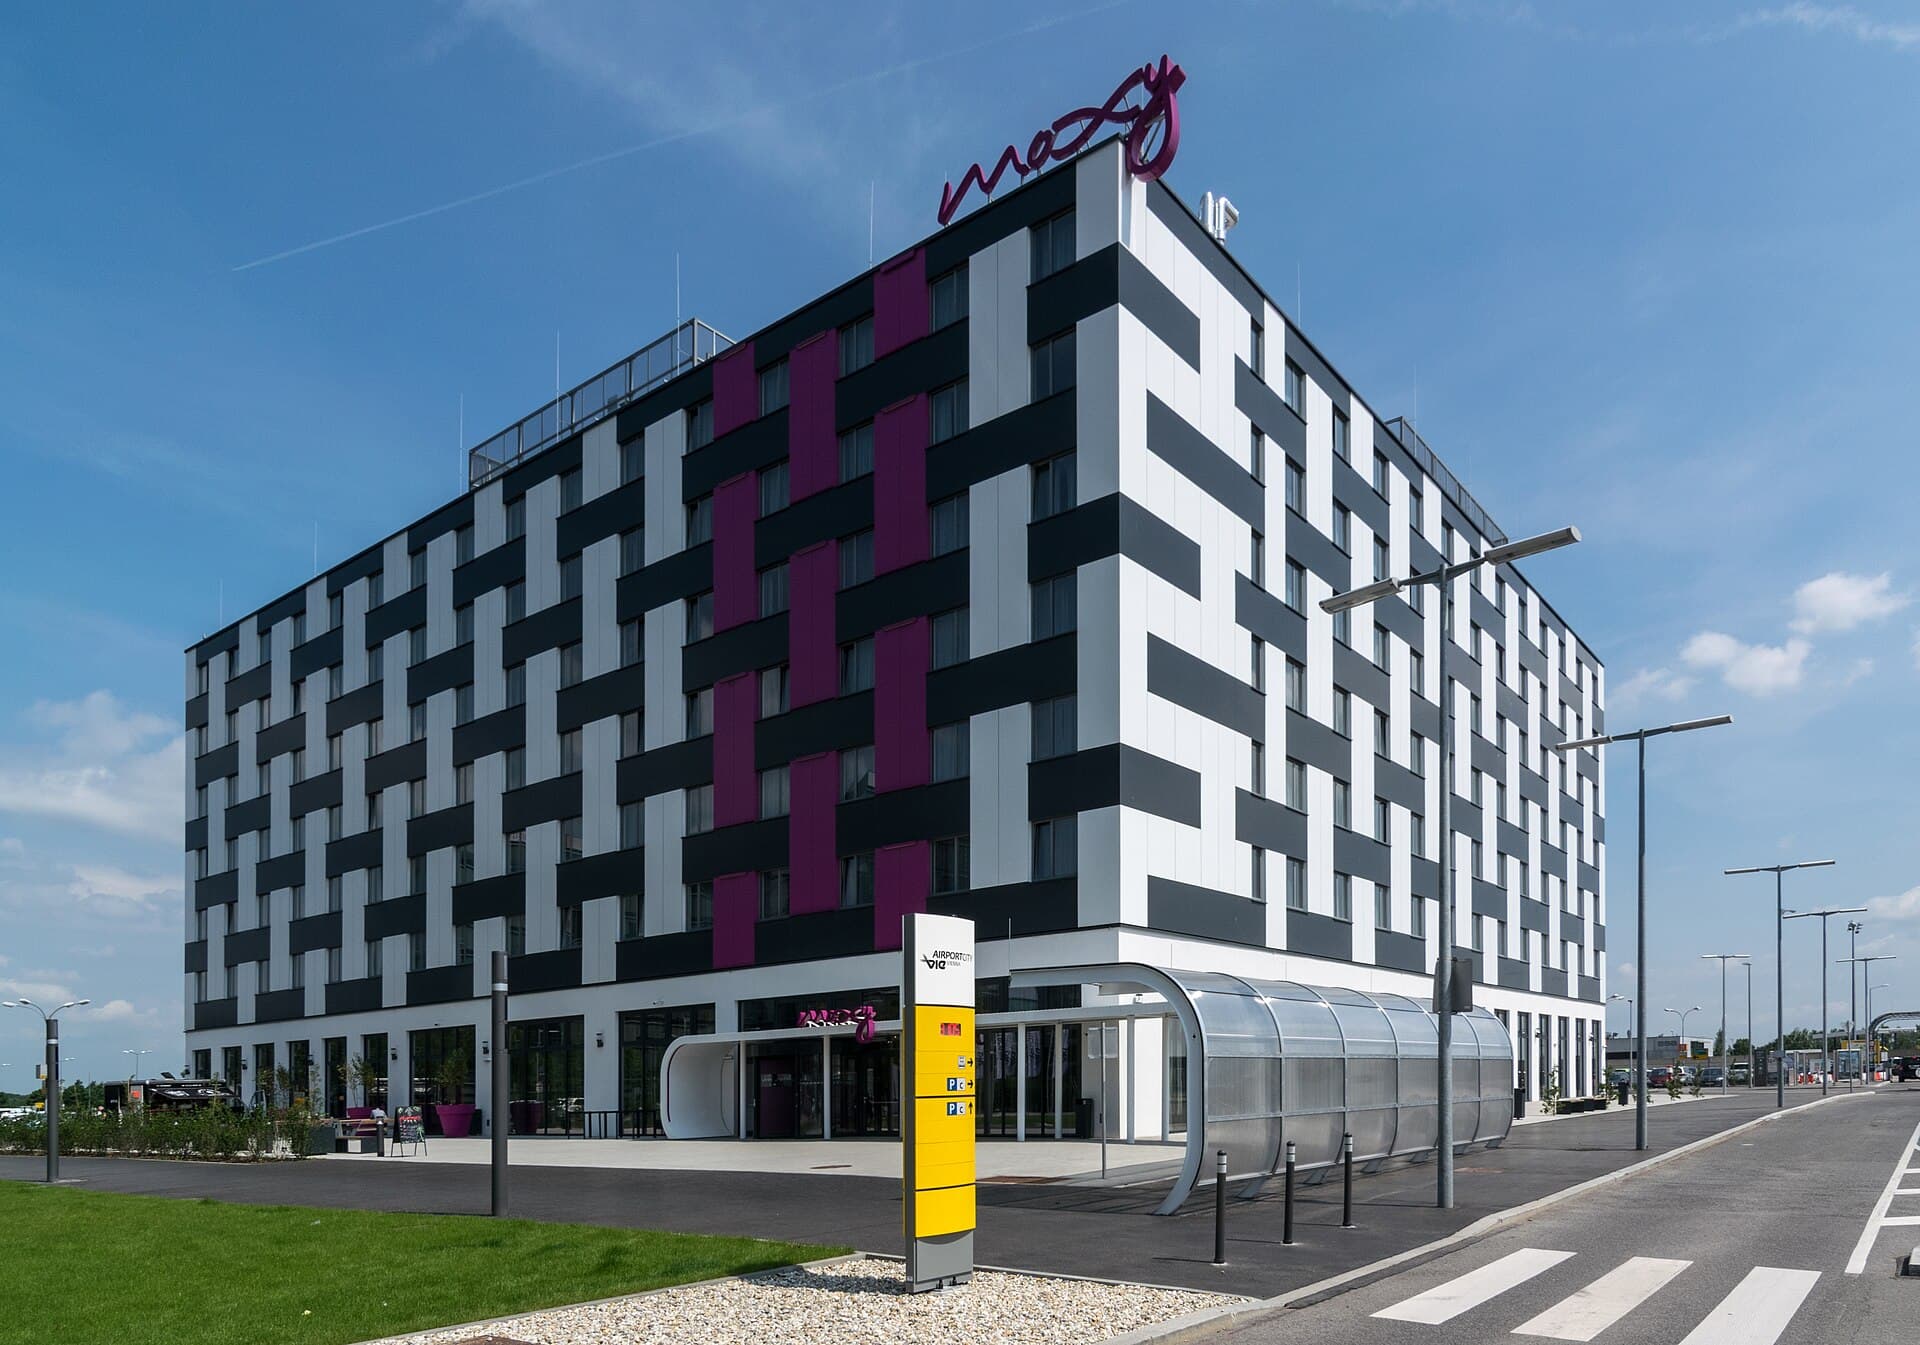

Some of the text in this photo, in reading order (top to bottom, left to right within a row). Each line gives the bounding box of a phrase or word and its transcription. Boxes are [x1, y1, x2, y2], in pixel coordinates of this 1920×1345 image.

[937, 54, 1187, 183] moxy
[949, 1079, 956, 1090] P
[949, 1103, 956, 1114] P
